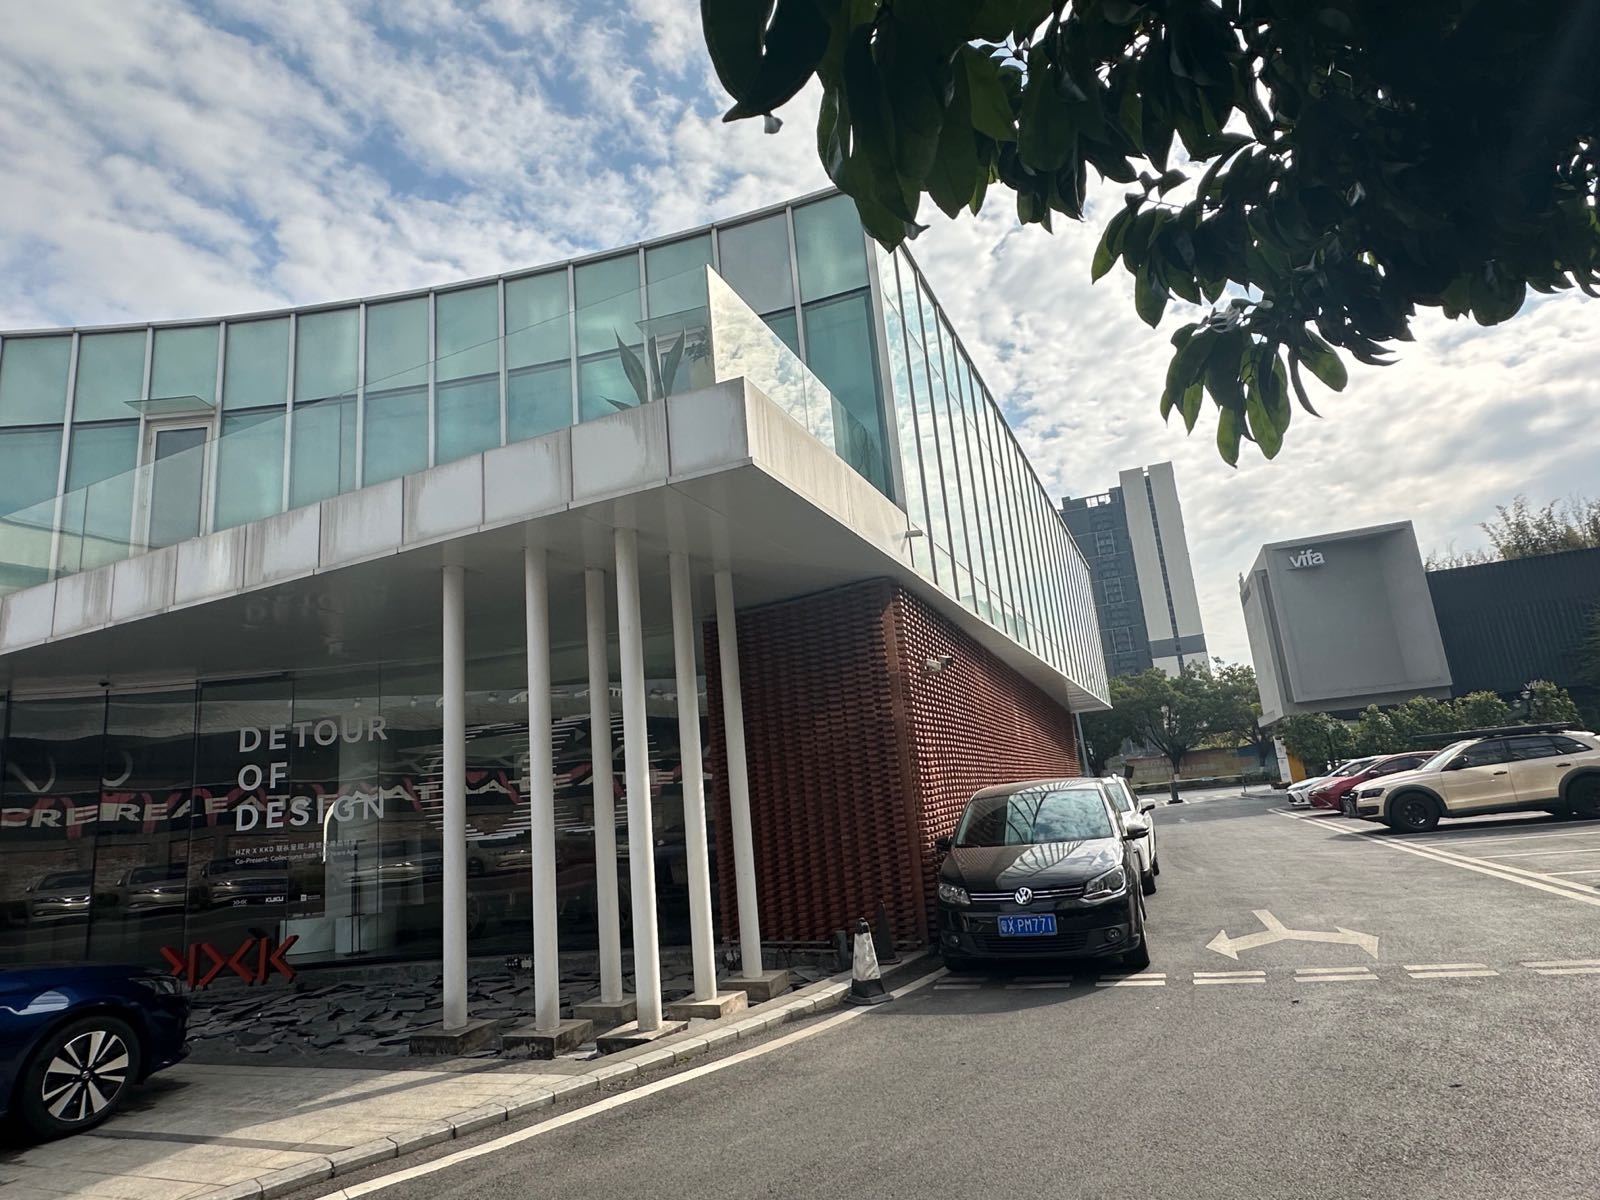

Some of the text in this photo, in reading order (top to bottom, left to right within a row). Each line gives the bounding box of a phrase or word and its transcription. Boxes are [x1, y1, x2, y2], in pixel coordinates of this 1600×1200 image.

[1289, 549, 1326, 567] vifa
[239, 715, 388, 752] DETOUR
[237, 762, 288, 791] OF
[235, 793, 385, 831] DESIGN
